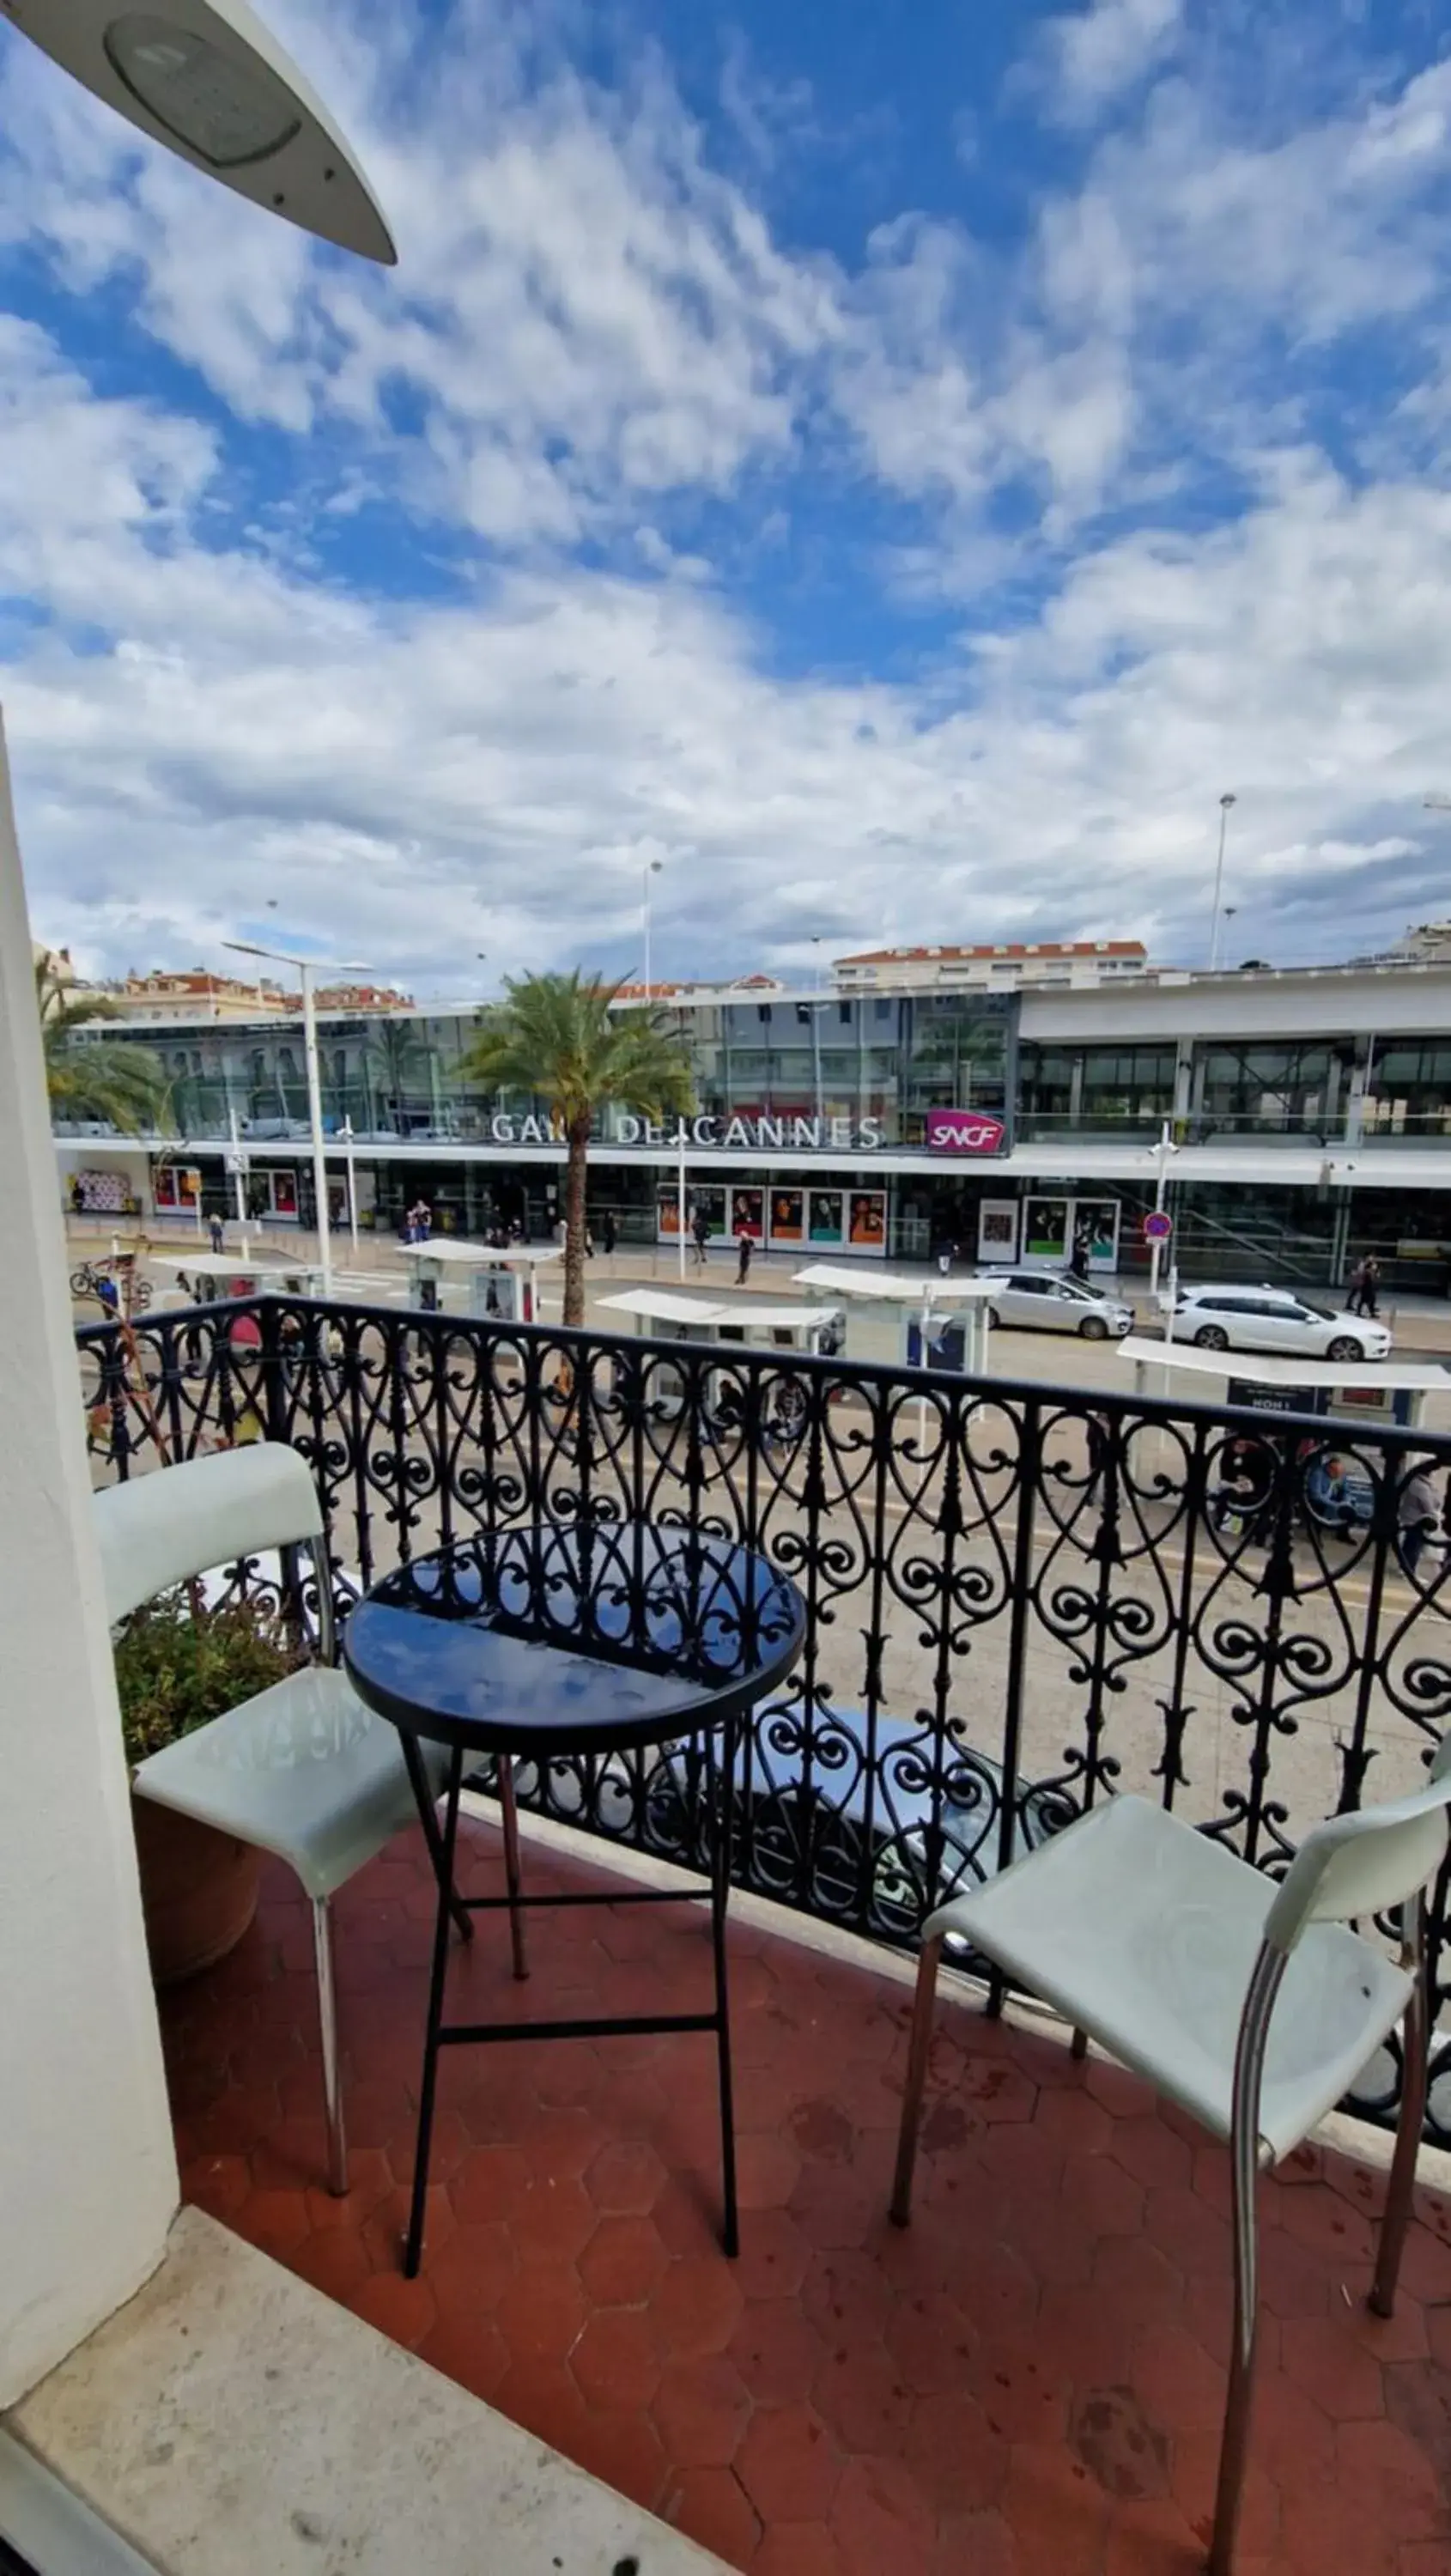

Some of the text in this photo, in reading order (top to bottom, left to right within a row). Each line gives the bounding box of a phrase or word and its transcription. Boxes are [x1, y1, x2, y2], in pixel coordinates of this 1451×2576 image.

[616, 1115, 663, 1145] DE
[693, 1115, 880, 1149] CANNES
[931, 1126, 998, 1146] SNCF
